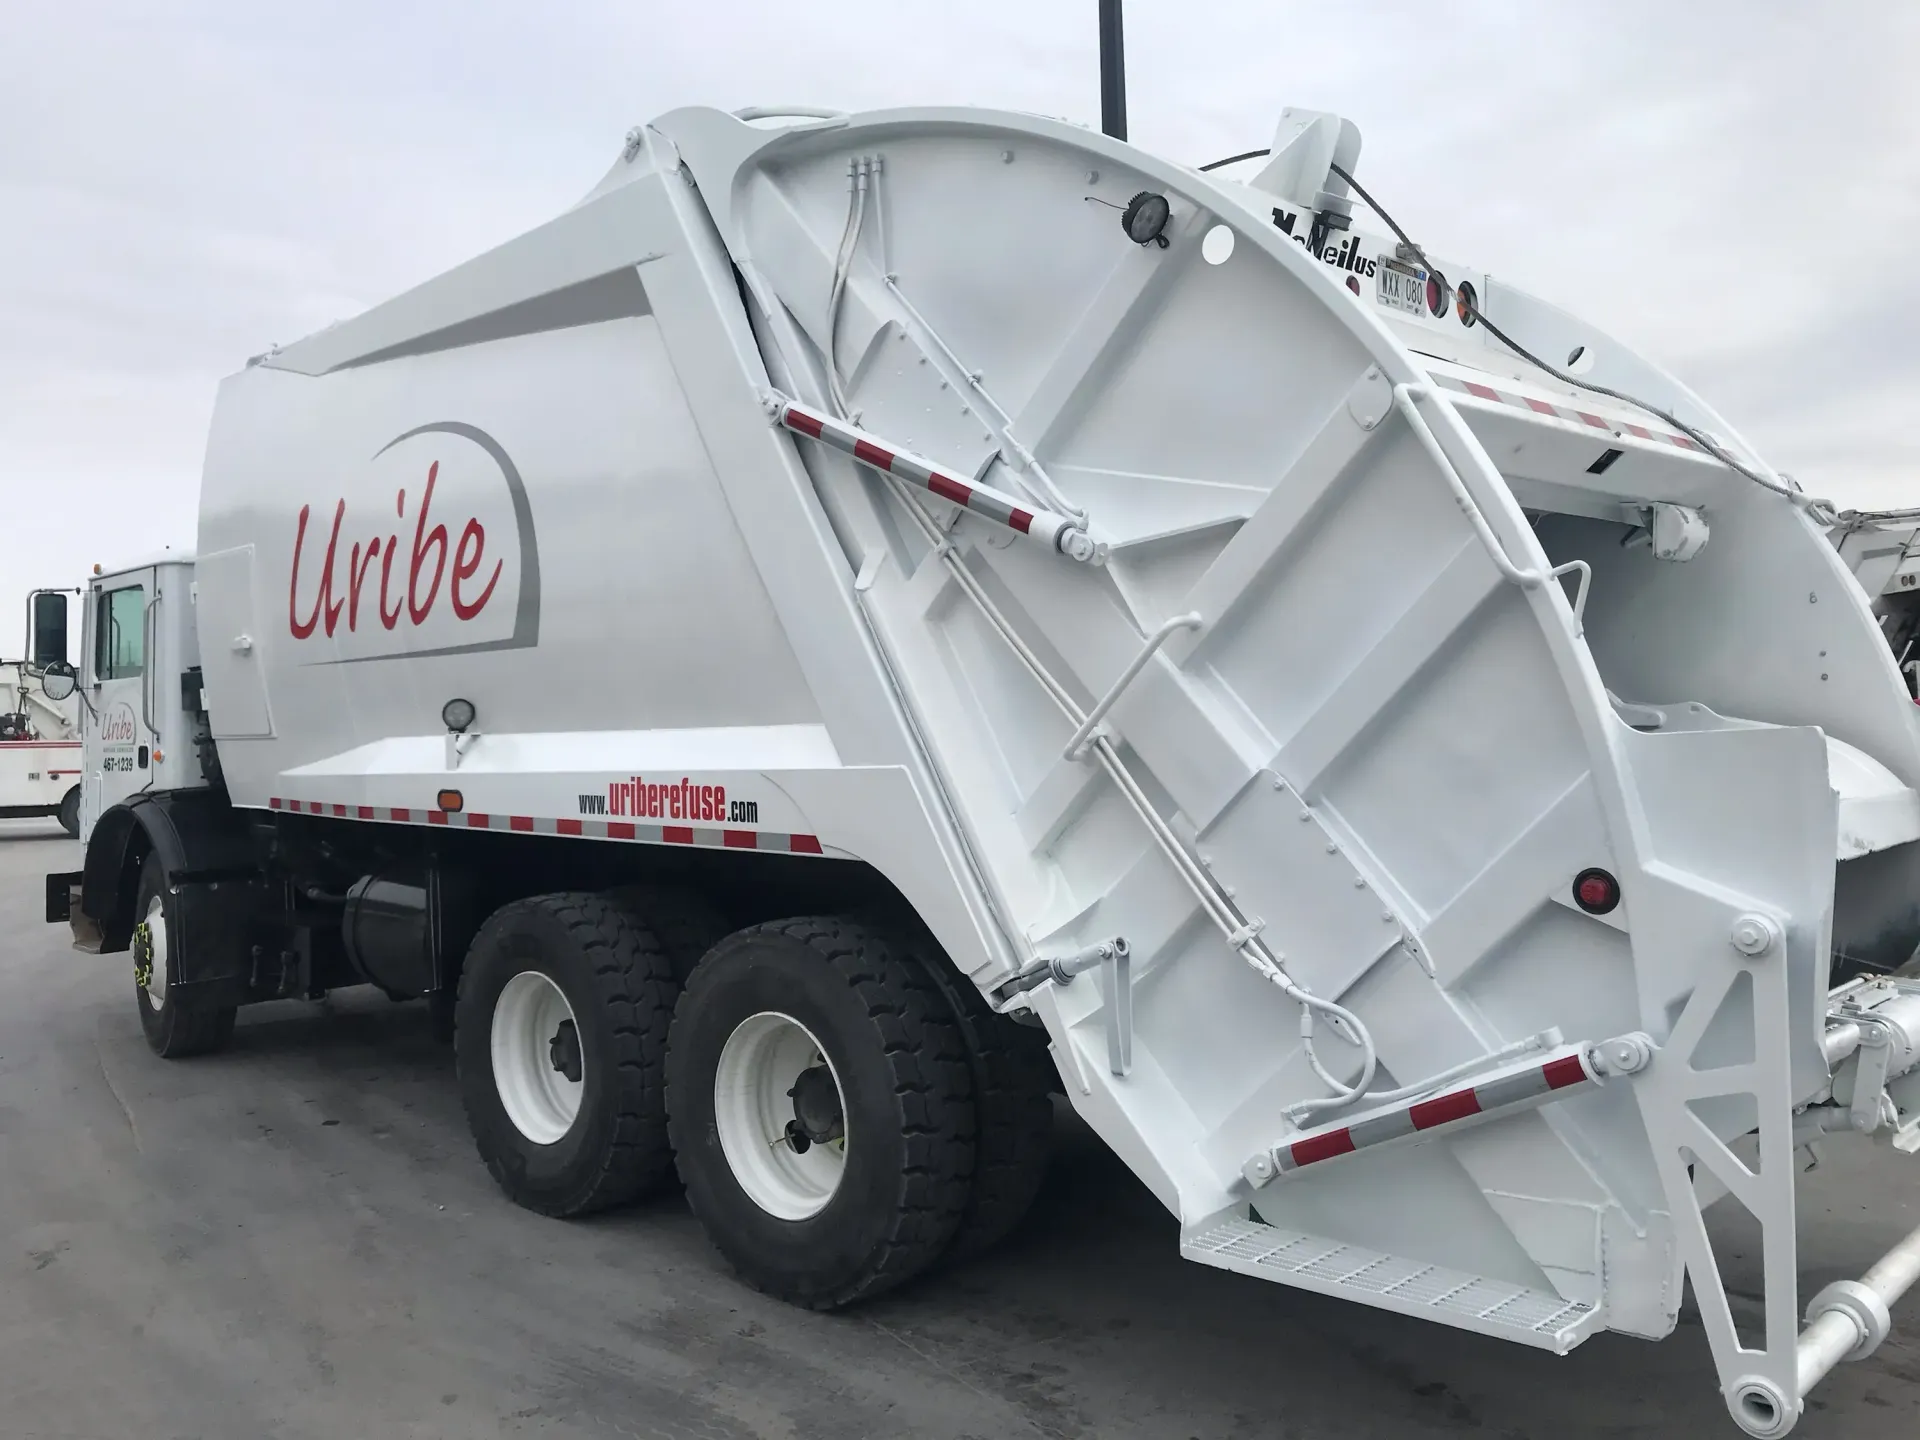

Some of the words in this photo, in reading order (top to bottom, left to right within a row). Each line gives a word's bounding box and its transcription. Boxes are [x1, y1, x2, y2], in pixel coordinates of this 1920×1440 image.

[1406, 278, 1422, 305] 080
[290, 460, 503, 640] Uribe
[102, 710, 133, 741] Uribe
[103, 757, 133, 772] 467-1239
[578, 776, 758, 823] www.uriberefuse.com
